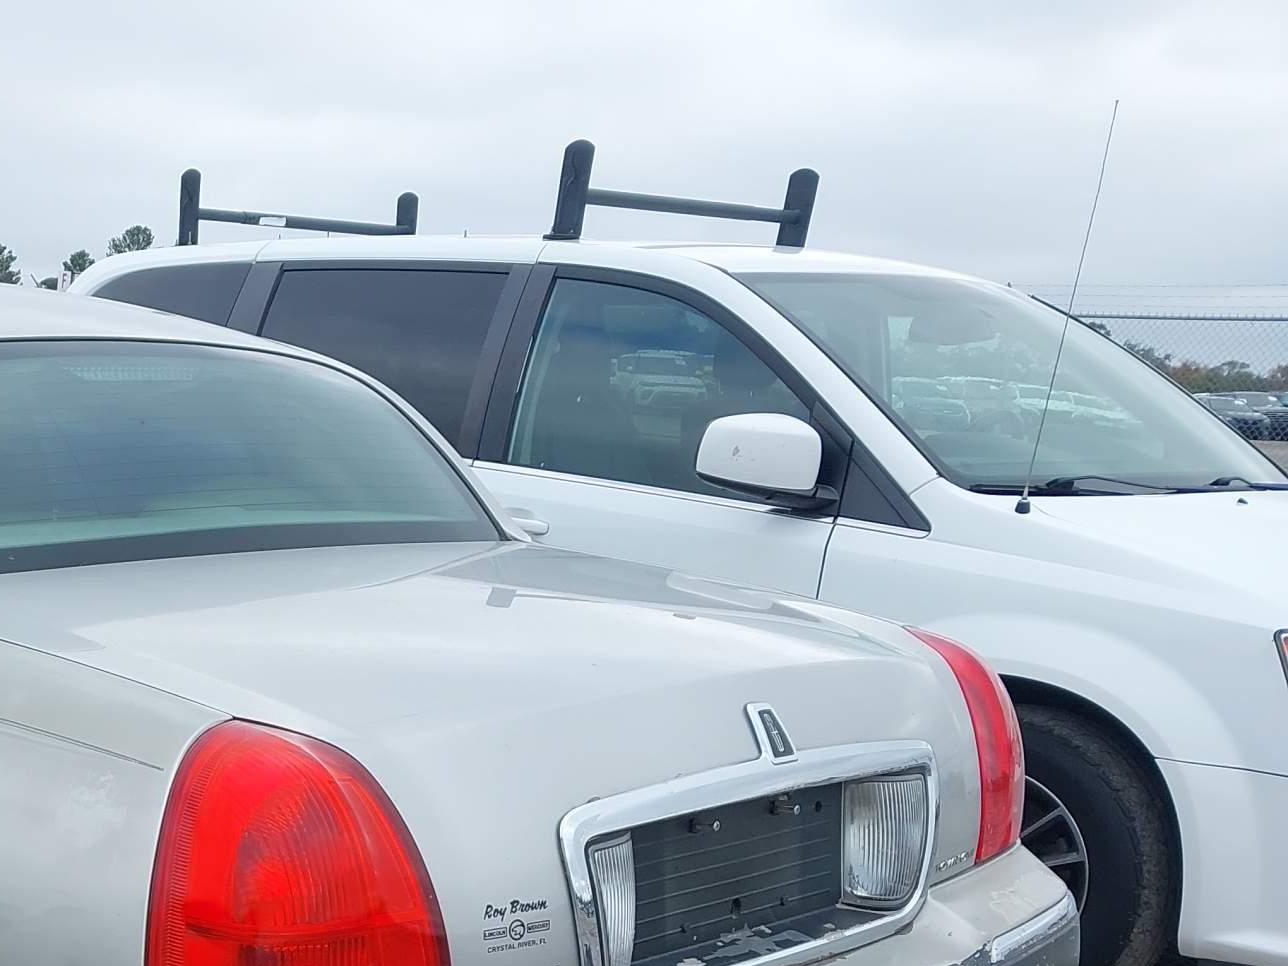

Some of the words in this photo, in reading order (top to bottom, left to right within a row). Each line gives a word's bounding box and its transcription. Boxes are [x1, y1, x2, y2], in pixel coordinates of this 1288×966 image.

[484, 904, 507, 922] Roy
[510, 900, 548, 914] Brown
[484, 929, 506, 938] LINCOLN
[487, 943, 515, 953] CRYSTAL
[517, 939, 538, 948] RIVER,
